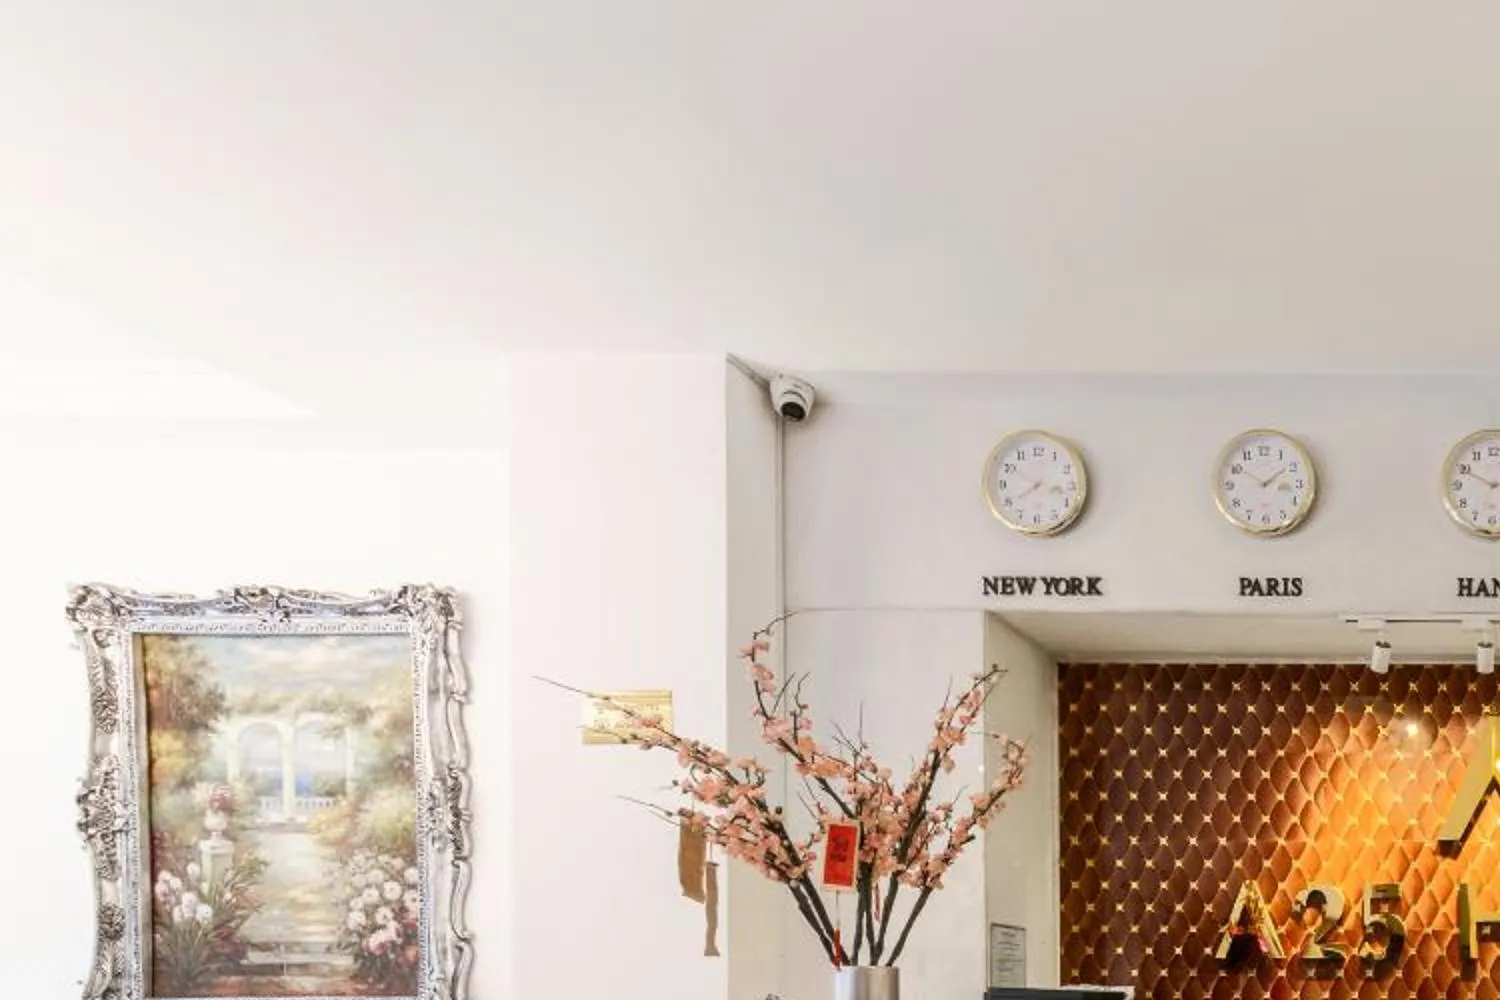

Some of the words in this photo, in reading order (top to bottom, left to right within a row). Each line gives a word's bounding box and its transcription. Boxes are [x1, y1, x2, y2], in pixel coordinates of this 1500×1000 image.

[982, 577, 1037, 596] NEW
[1040, 577, 1103, 596] YORK
[1239, 577, 1303, 597] PARIS
[1214, 880, 1406, 968] A25
